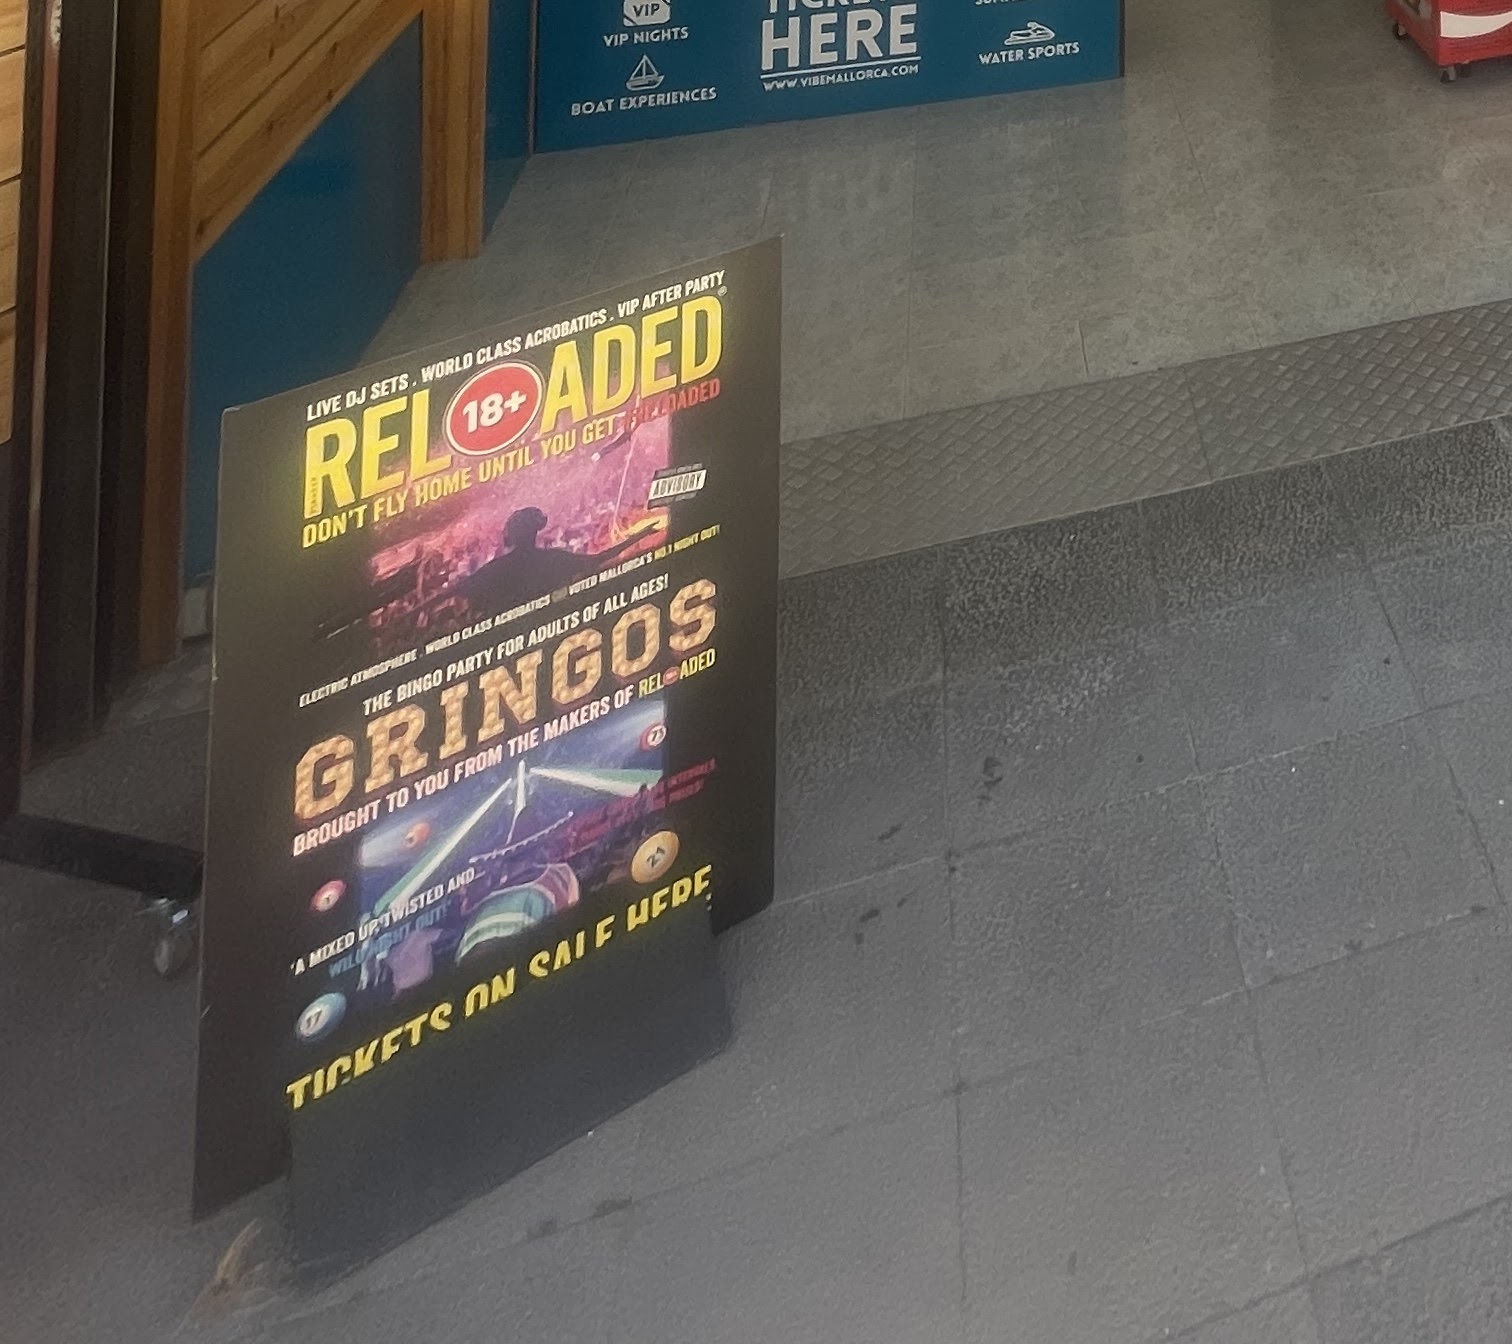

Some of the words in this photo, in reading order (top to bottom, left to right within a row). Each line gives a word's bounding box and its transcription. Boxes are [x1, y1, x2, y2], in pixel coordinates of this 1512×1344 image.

[603, 32, 629, 47] VIP
[633, 27, 689, 44] NIGHTS
[633, 3, 660, 17] VIP
[761, 3, 917, 70] HERE
[763, 64, 919, 91] WWW.VIBEMALLORCA.COM
[978, 49, 1024, 65] WATER
[1028, 42, 1080, 60] SPORTS
[571, 98, 614, 116] BOAT
[619, 87, 717, 110] EXPERIENCES
[307, 395, 342, 422] LIVE
[345, 390, 366, 409] DJ
[370, 373, 409, 401] SETS
[421, 352, 473, 384] WORLD
[476, 336, 522, 365] CLASS
[524, 308, 608, 349] ACROBATICS
[617, 298, 640, 317] VIP
[642, 284, 682, 310] AFTER
[685, 270, 725, 296] PARTY
[462, 390, 527, 434] 18+
[303, 505, 367, 548] DON'T
[373, 489, 409, 522] FLY
[414, 467, 472, 507] HOME
[478, 446, 535, 484] UNTIL
[540, 428, 576, 459] YOU
[581, 416, 615, 445] GET
[652, 471, 704, 497] ADVISORY
[299, 677, 350, 708] ELECTRIC
[350, 648, 418, 686] ATMOSPHERE
[425, 631, 460, 655] WORLD
[461, 620, 492, 640] CLASS
[494, 594, 551, 627] ACROBATICS
[568, 574, 599, 596] VOTED
[599, 551, 653, 582] MALLORCA'S
[674, 532, 700, 554] NIGHT
[362, 689, 393, 716] THE
[397, 669, 443, 703] BINGO
[446, 647, 495, 682] PARTY
[496, 634, 525, 660] FOR
[527, 609, 580, 643] ADULTS
[582, 601, 601, 623] OF
[603, 589, 630, 615] ALL
[630, 573, 670, 603] AGES!
[294, 578, 717, 820] GRINGOS
[293, 799, 382, 858] BROUGHT
[385, 786, 410, 813] TO
[414, 768, 450, 801] YOU
[453, 744, 503, 783] FROM
[507, 726, 540, 758] THE
[543, 695, 611, 742] MAKERS
[614, 684, 635, 709] OF
[309, 931, 356, 968] MIXED
[380, 883, 445, 928] TWISTED
[285, 1002, 454, 1110] TICKETS
[464, 967, 516, 1018] ON
